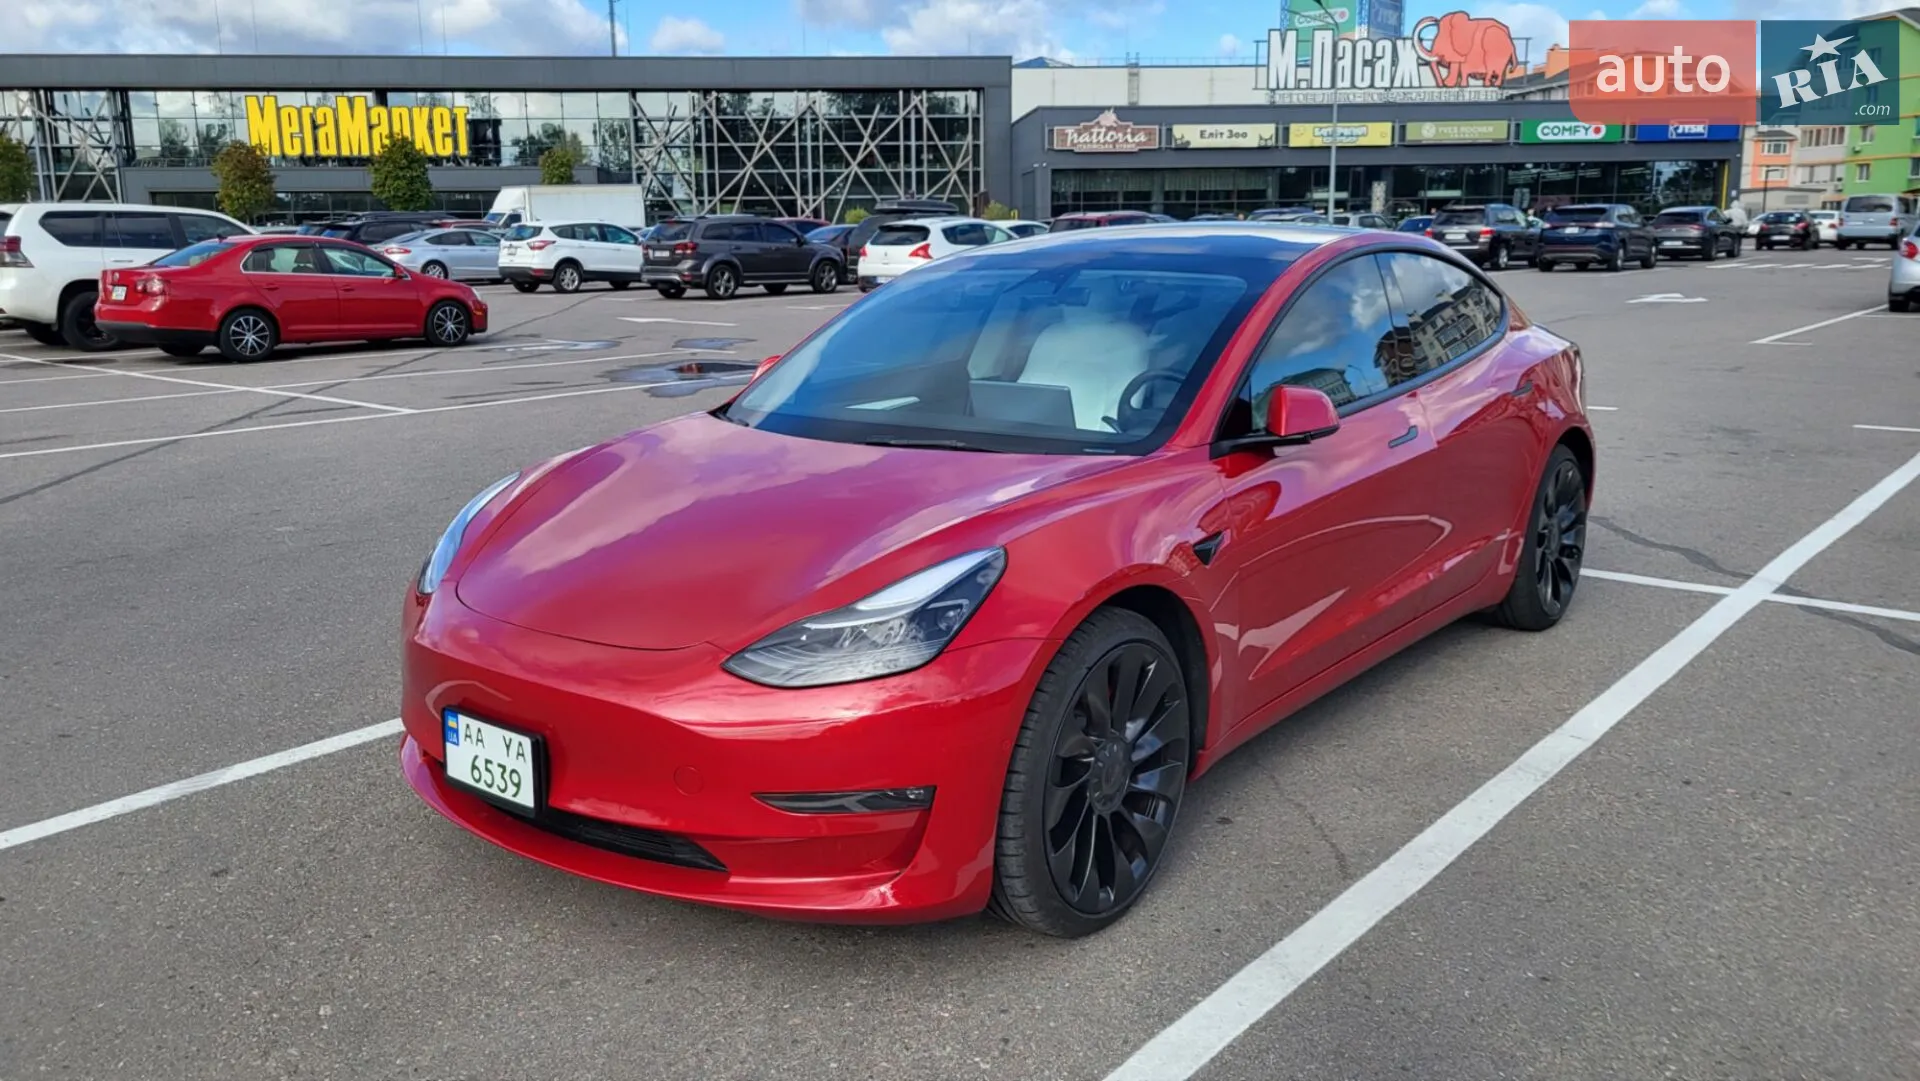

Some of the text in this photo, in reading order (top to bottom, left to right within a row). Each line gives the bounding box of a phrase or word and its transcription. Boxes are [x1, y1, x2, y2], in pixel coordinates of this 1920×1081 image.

[1065, 126, 1148, 147] Trattoria
[1226, 129, 1248, 139] Зоо
[1541, 125, 1592, 137] COMFY
[447, 731, 458, 743] UA
[464, 723, 526, 763] AA YA
[470, 755, 522, 798] 6539
